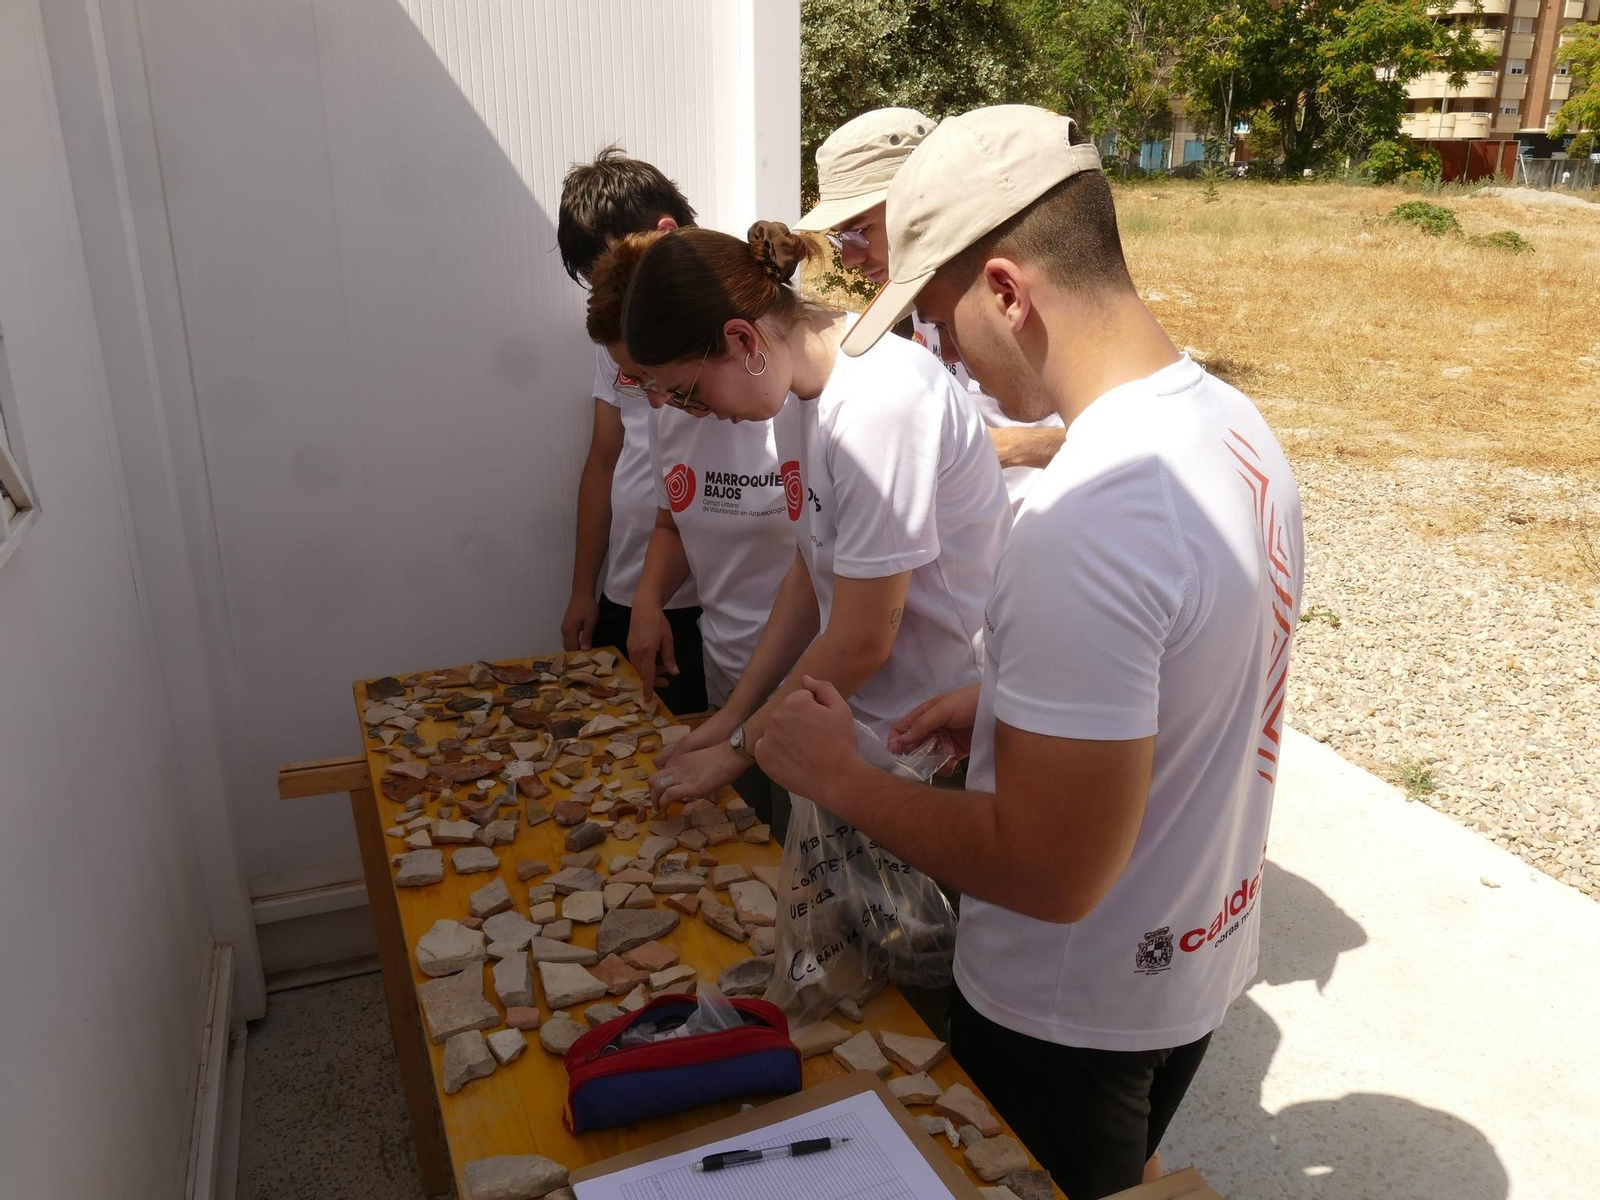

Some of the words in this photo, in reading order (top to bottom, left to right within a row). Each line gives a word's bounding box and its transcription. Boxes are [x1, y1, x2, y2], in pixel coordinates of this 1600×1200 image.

[705, 471, 784, 487] MARROQUÍE
[704, 485, 742, 500] BAJOS
[702, 500, 720, 508] Campo
[720, 501, 739, 509] Urbano
[709, 506, 740, 516] Voluntariado
[1214, 920, 1240, 948] obras
